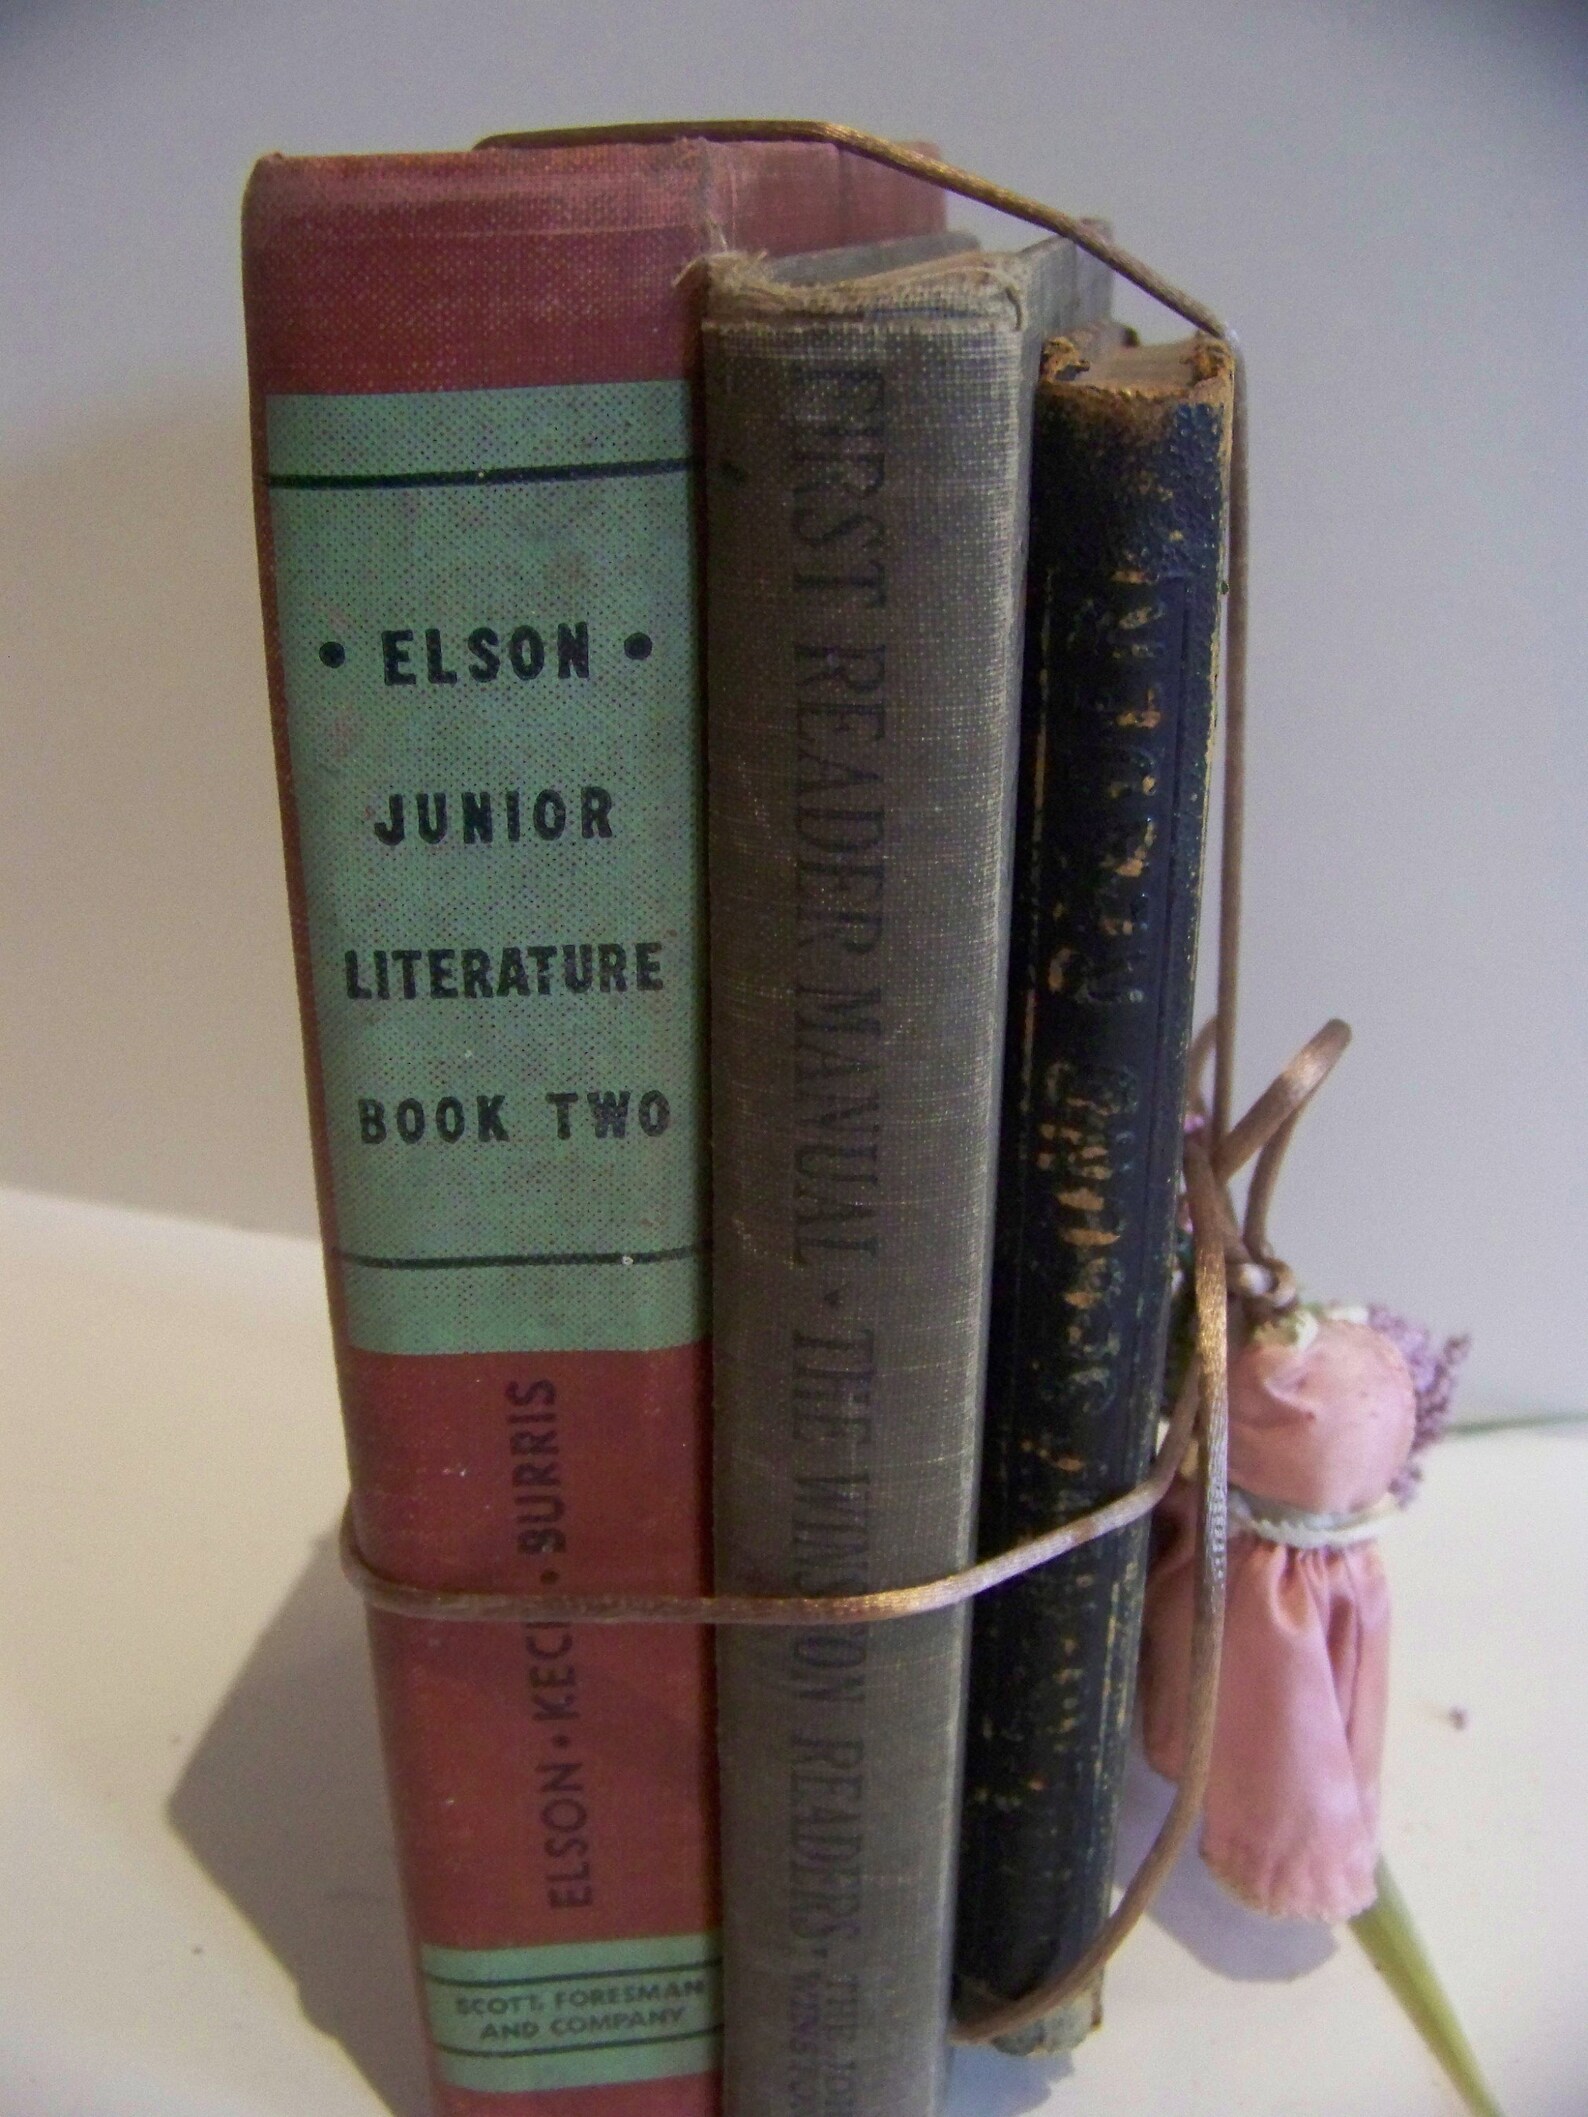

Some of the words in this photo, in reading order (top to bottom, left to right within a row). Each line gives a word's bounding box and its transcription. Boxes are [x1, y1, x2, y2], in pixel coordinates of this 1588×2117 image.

[792, 367, 885, 608] FIRST
[381, 620, 592, 686] ELSON
[374, 785, 614, 847] JUNIOR
[793, 642, 885, 955] READER
[344, 941, 664, 1001] LITERATURE
[358, 1094, 511, 1145] BOOK
[545, 1089, 671, 1142] TWO
[792, 982, 881, 1268] MANUAL
[791, 1330, 874, 1441] THE
[504, 1377, 568, 1557] BURRIS
[791, 1469, 868, 1704] WINSON
[534, 1761, 593, 1910] ELSON
[479, 2019, 541, 2041] AND
[549, 2006, 686, 2037] COMPANY
[554, 1979, 706, 2010] FORESMAN
